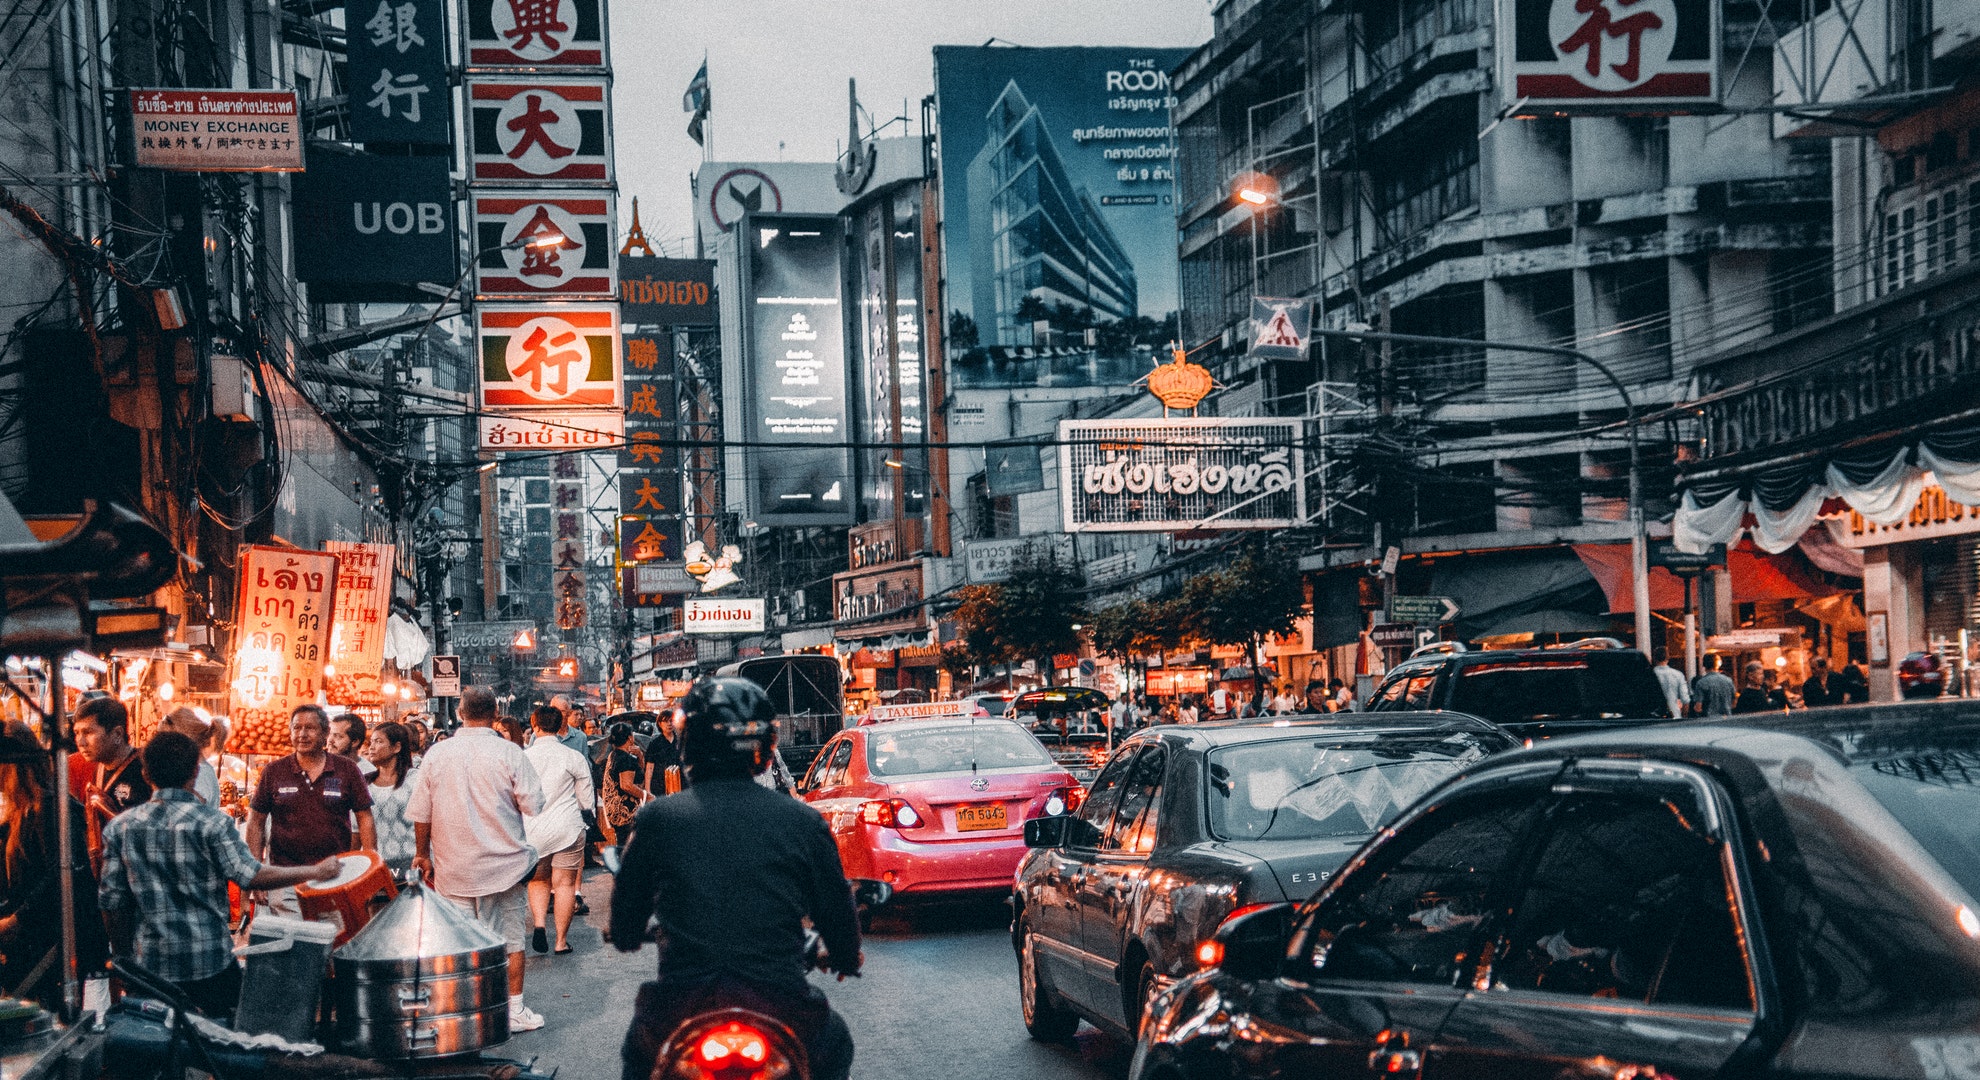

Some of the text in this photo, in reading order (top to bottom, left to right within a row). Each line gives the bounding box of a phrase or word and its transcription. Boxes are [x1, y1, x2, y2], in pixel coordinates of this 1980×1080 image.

[1129, 59, 1155, 68] THE
[138, 92, 293, 114] รับซื้อ-ขาย เงินตราต่างประเทศ
[144, 121, 290, 133] MONEY EXCHANGE
[353, 201, 445, 234] UOB
[257, 557, 324, 593] เล้ง
[253, 596, 295, 619] เกา
[295, 636, 319, 661] มือ
[887, 702, 961, 718] TAXI-METER
